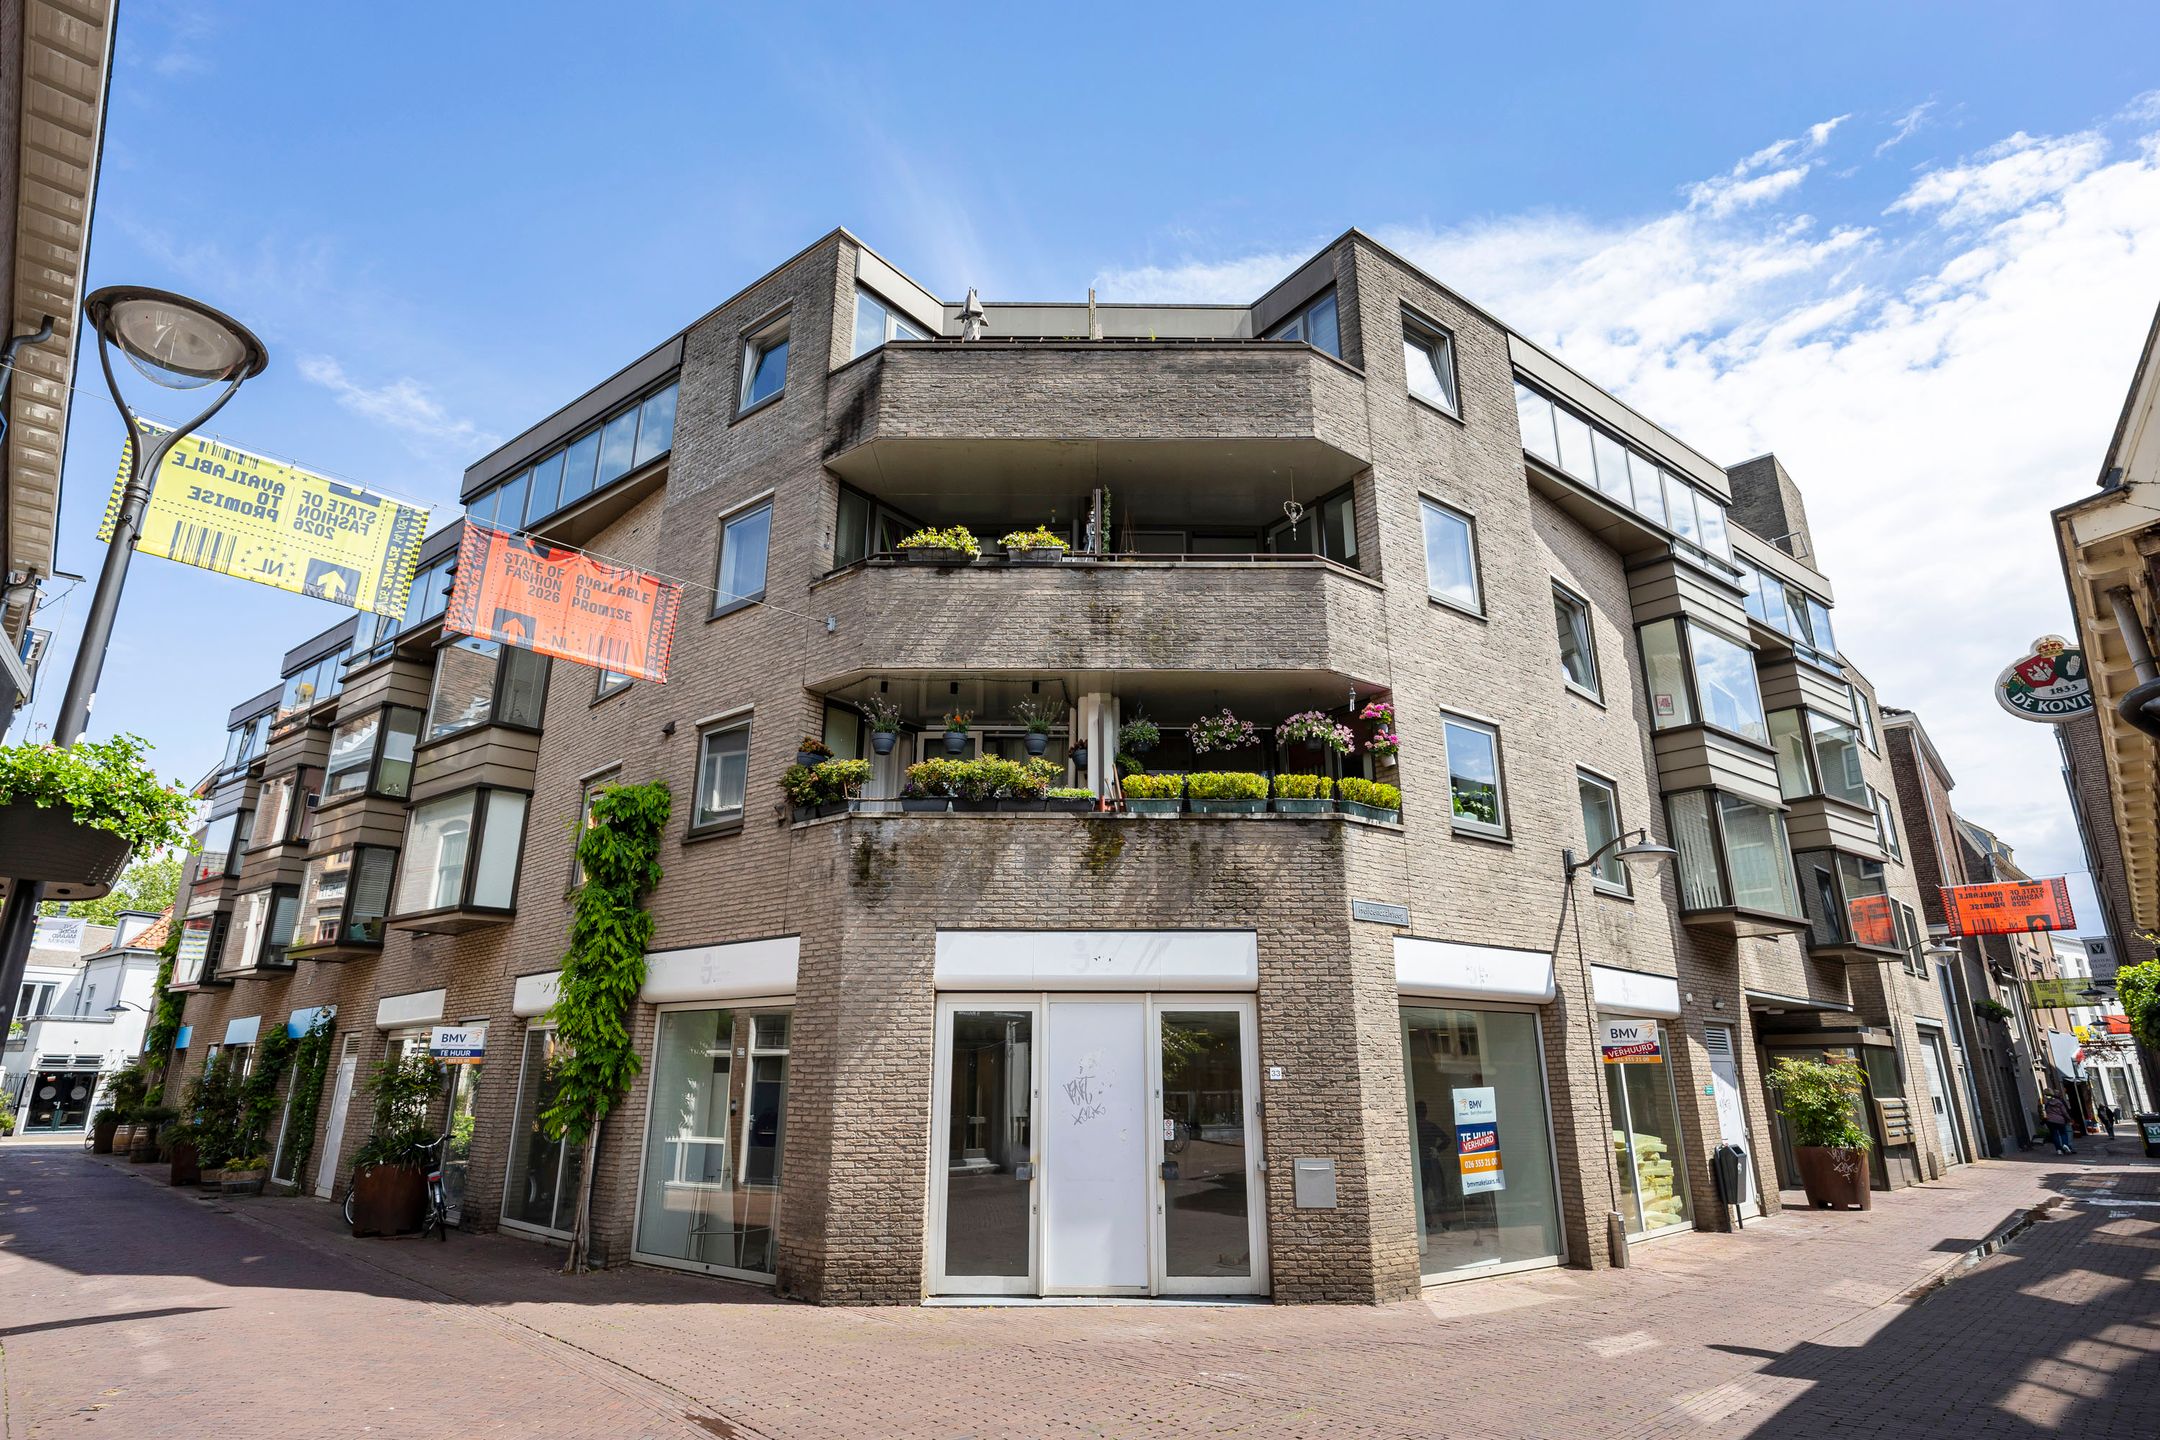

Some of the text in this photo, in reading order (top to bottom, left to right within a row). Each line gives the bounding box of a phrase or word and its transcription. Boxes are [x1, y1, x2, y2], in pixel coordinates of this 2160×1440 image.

[504, 552, 565, 578] STATE OF
[505, 564, 563, 592] FASHION
[527, 585, 561, 604] 2026
[575, 584, 592, 601] TO
[576, 574, 651, 605] AVAILABLE
[571, 596, 633, 623] PROMISE
[2049, 684, 2079, 695] 1833
[2011, 692, 2035, 709] DE
[441, 1033, 467, 1043] BMV
[1610, 1028, 1638, 1039] BMV
[1608, 1043, 1655, 1058] VERHUURD
[1469, 1100, 1482, 1109] BMV
[1463, 1135, 1494, 1151] VERHUURD
[1464, 1160, 1474, 1169] 026
[1485, 1158, 1491, 1166] 21
[1491, 1157, 1498, 1166] 00
